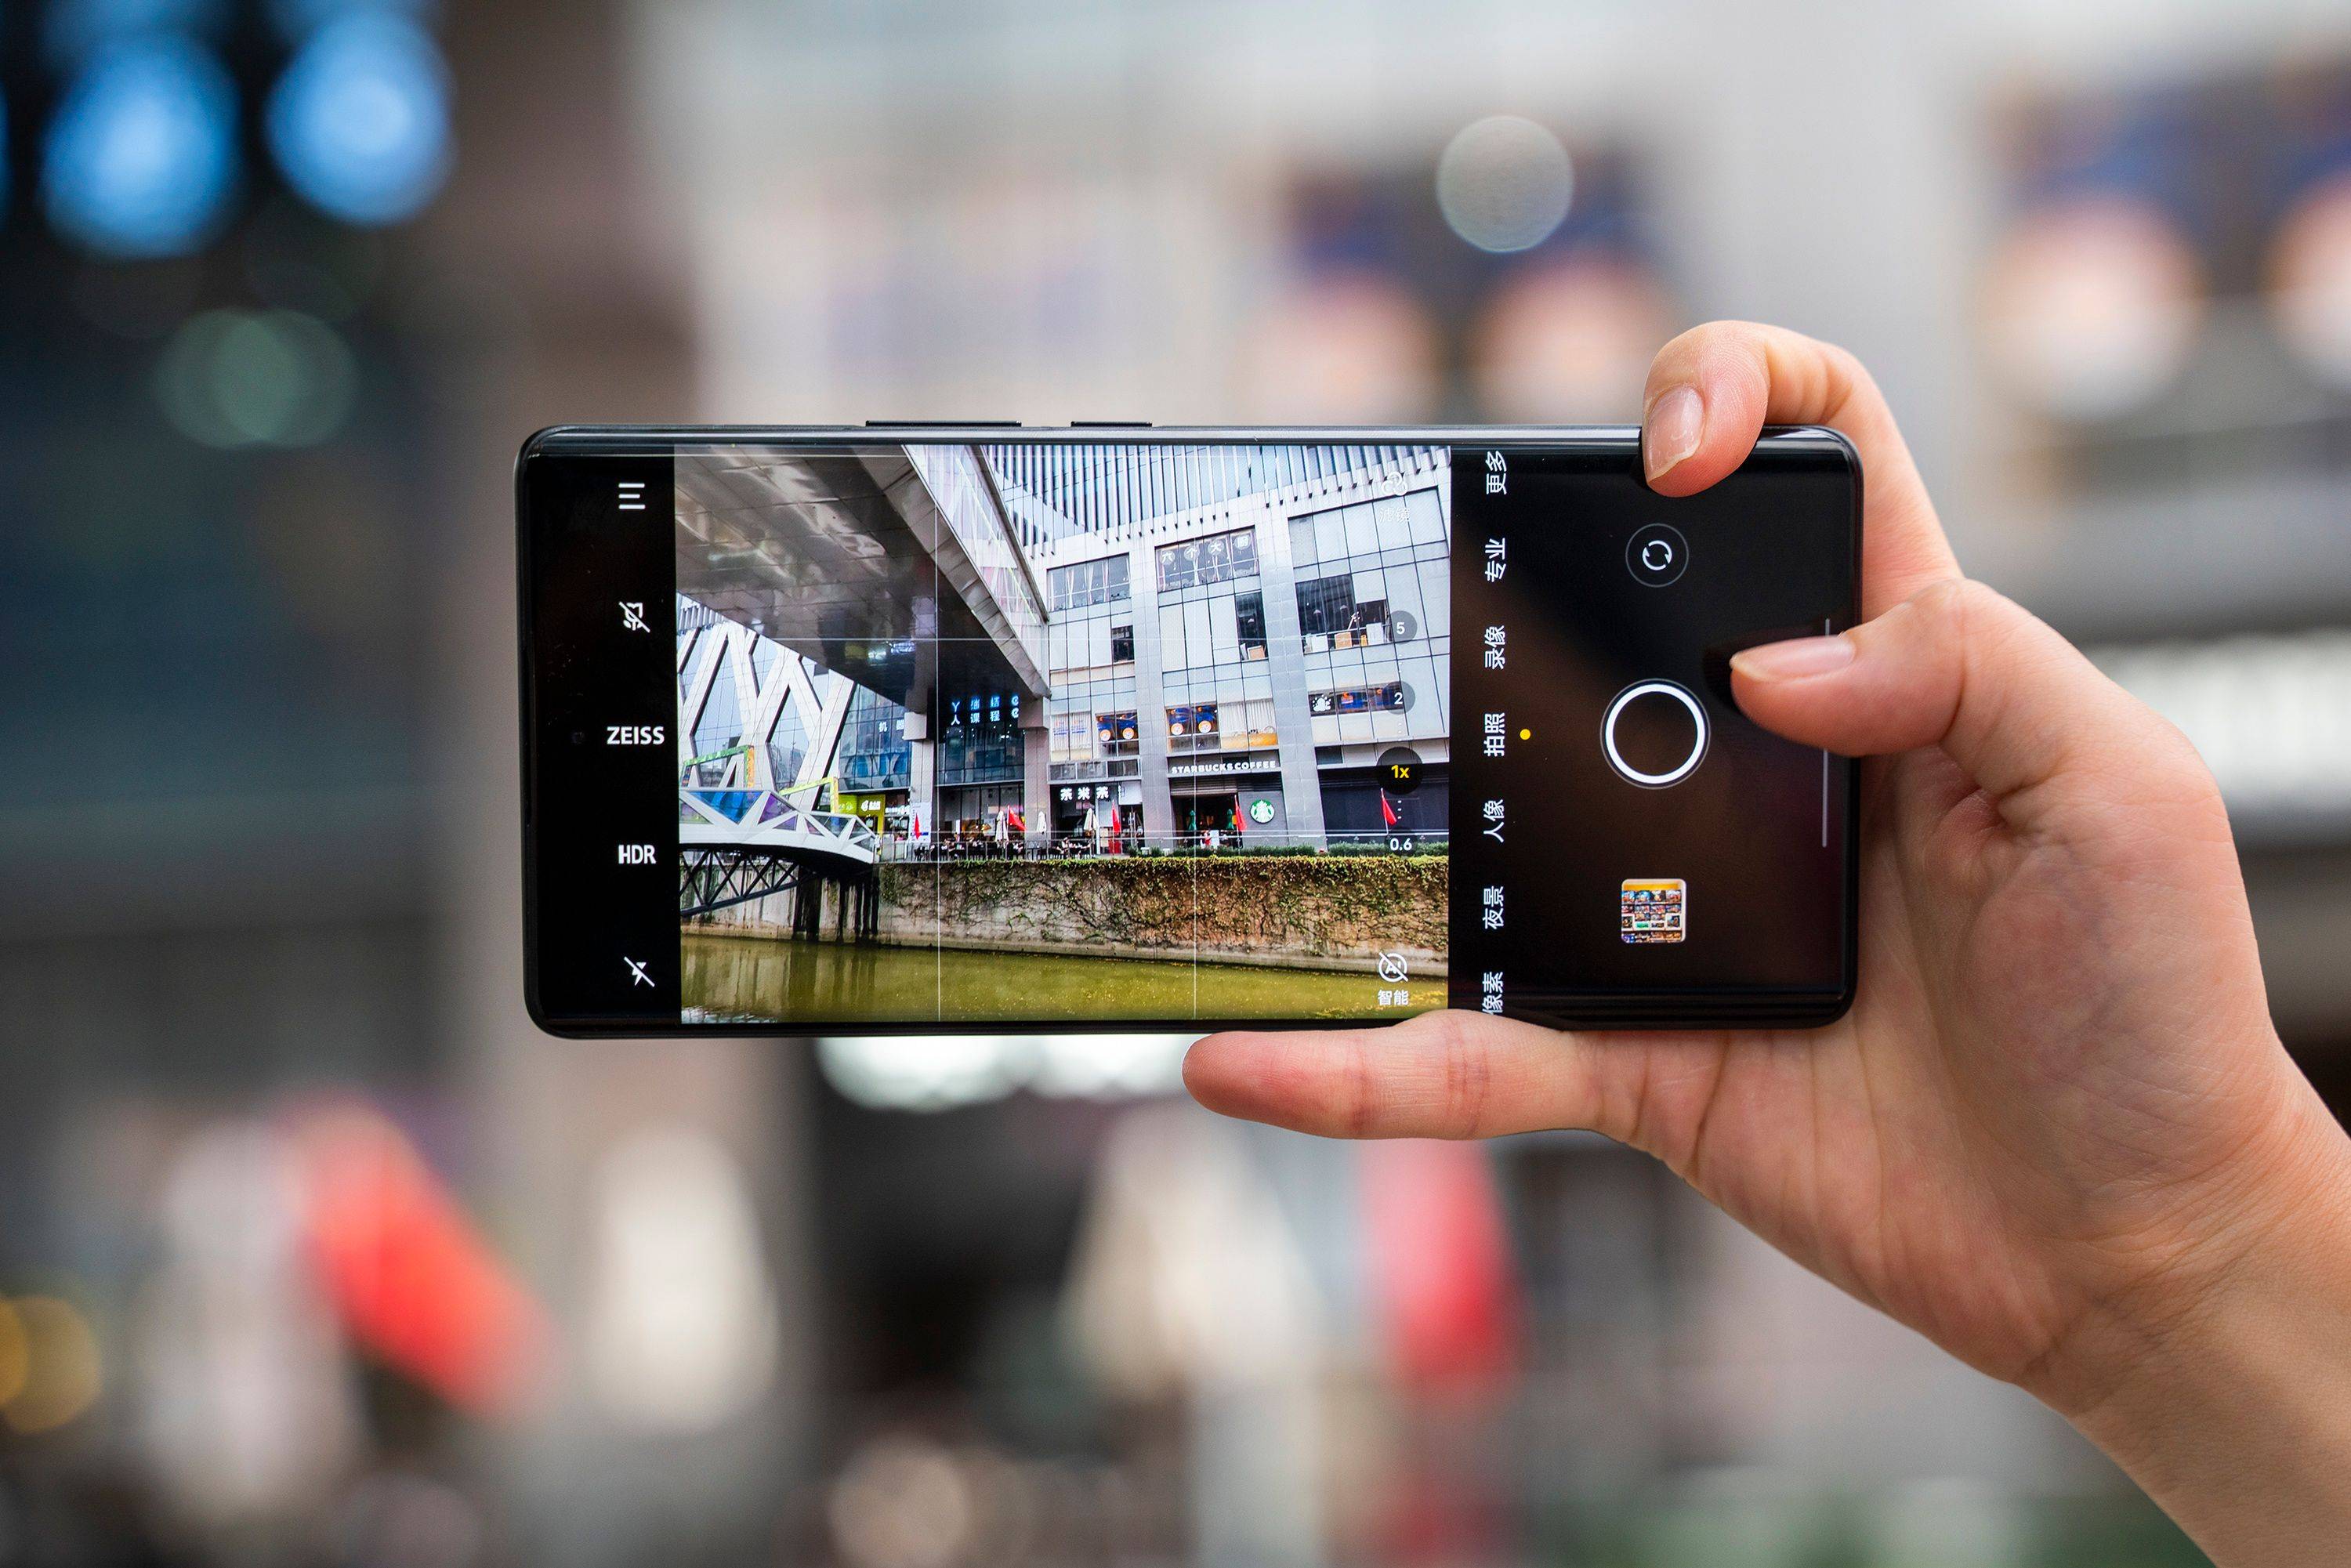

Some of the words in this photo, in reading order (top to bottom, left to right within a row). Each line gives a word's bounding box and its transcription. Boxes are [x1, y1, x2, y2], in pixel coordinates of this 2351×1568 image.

[1485, 450, 1507, 495] 更多
[1484, 538, 1507, 583] 专业
[1396, 621, 1405, 635] 5
[1483, 625, 1506, 670] 录像
[1393, 692, 1404, 705] 2
[607, 726, 665, 745] ZEISS
[1483, 712, 1505, 757] 拍照
[1171, 762, 1233, 774] STARBUCKS
[1234, 760, 1277, 771] COFFEE
[1391, 764, 1410, 779] 1x
[1483, 798, 1505, 843] 人像
[618, 844, 657, 864] HDR
[1389, 838, 1412, 851] 0.6
[1482, 885, 1505, 929] 夜景
[1378, 990, 1409, 1006] 智能
[1482, 972, 1503, 1015] 像素
